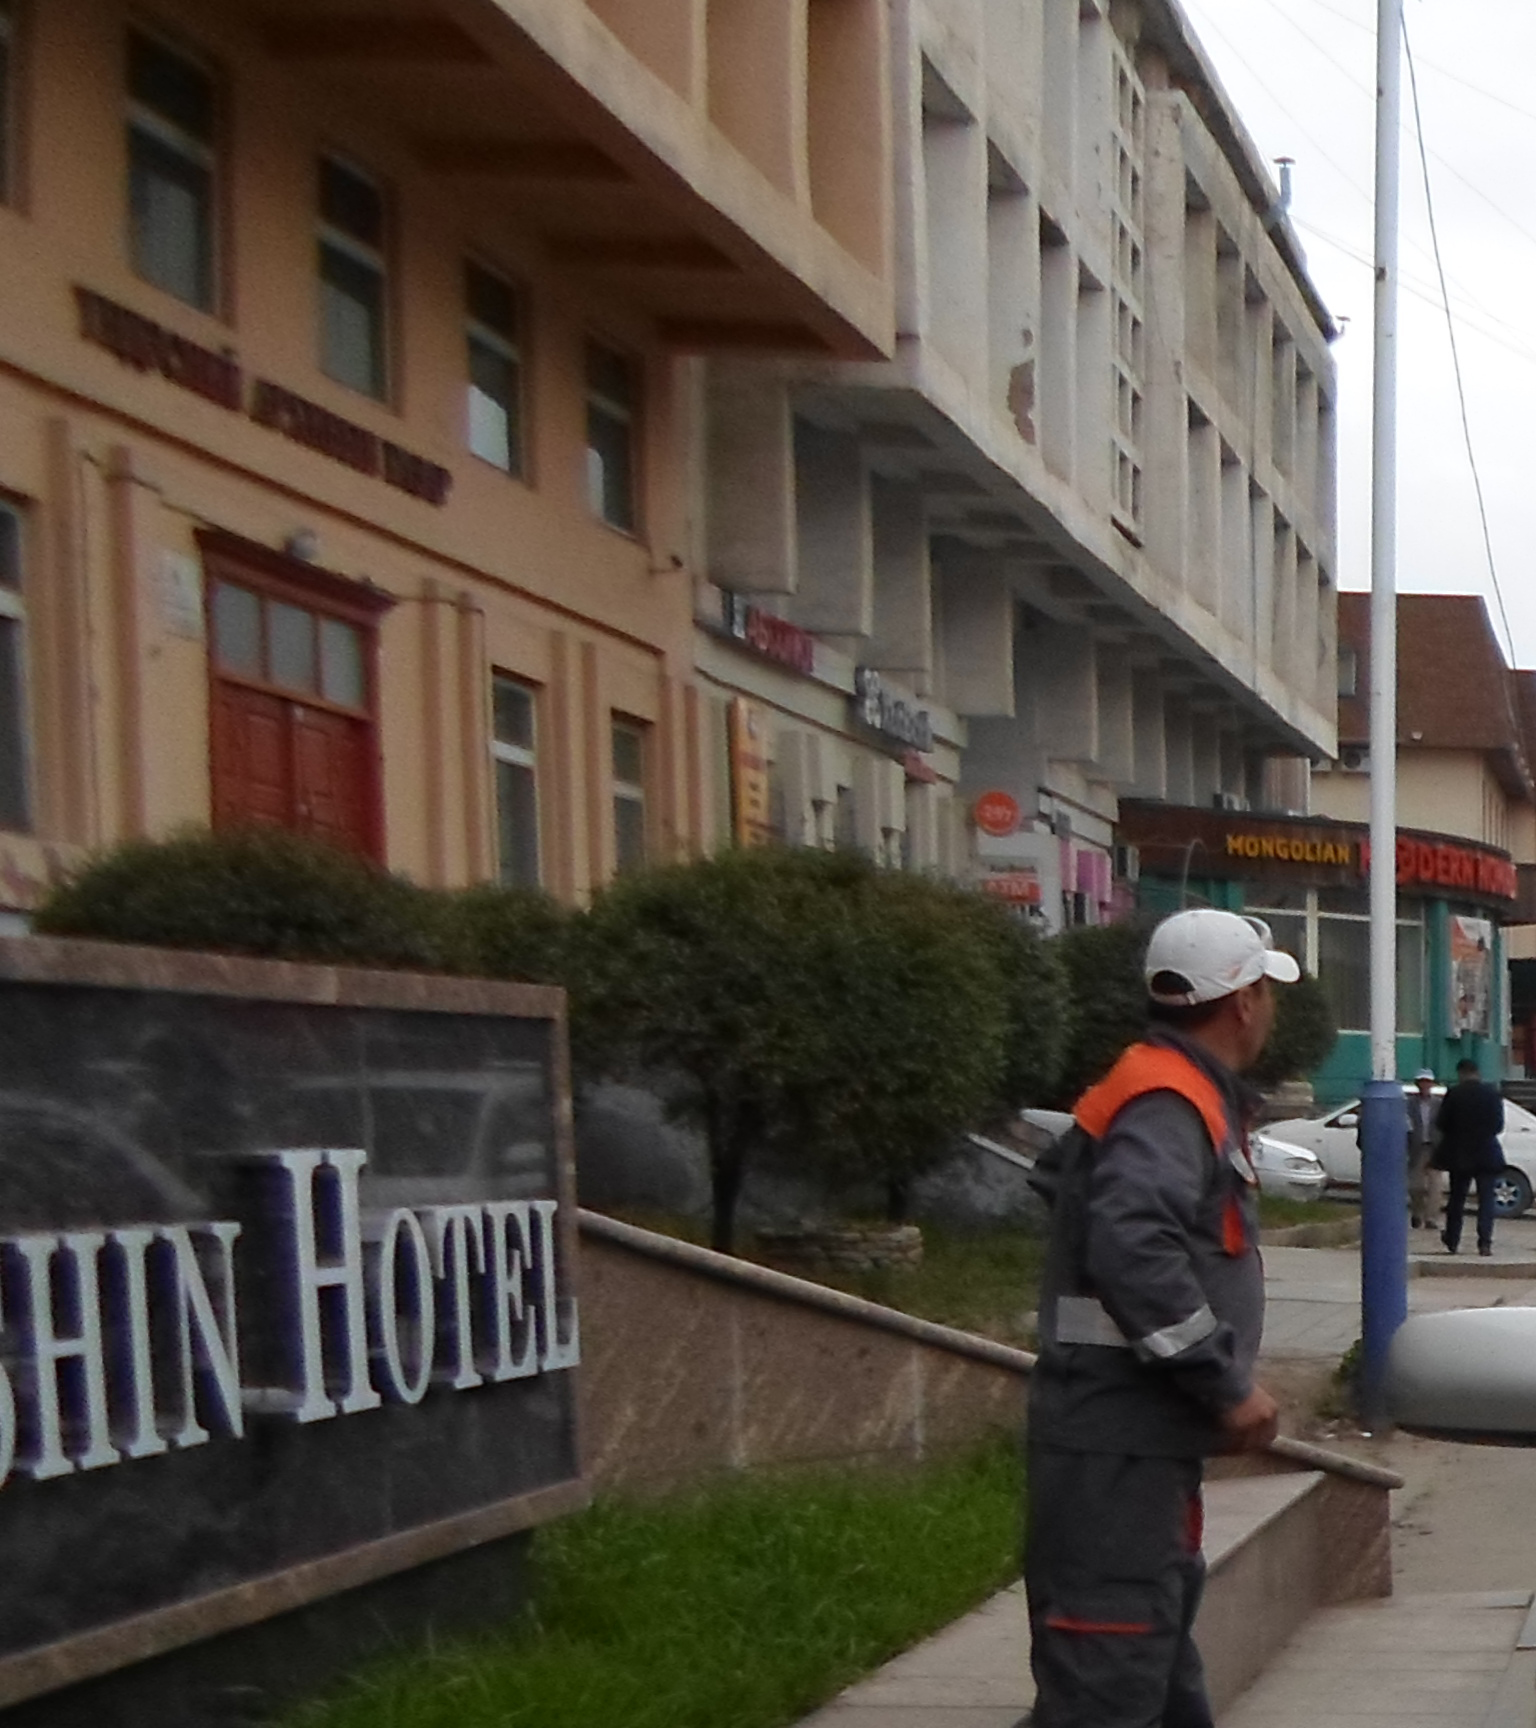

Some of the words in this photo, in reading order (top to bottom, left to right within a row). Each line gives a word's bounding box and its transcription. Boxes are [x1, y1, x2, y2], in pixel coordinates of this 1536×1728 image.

[1226, 833, 1350, 865] MONGOLIAN
[1359, 834, 1475, 888] ODERN
[986, 880, 1031, 897] ATM
[0, 1222, 244, 1488] HIN
